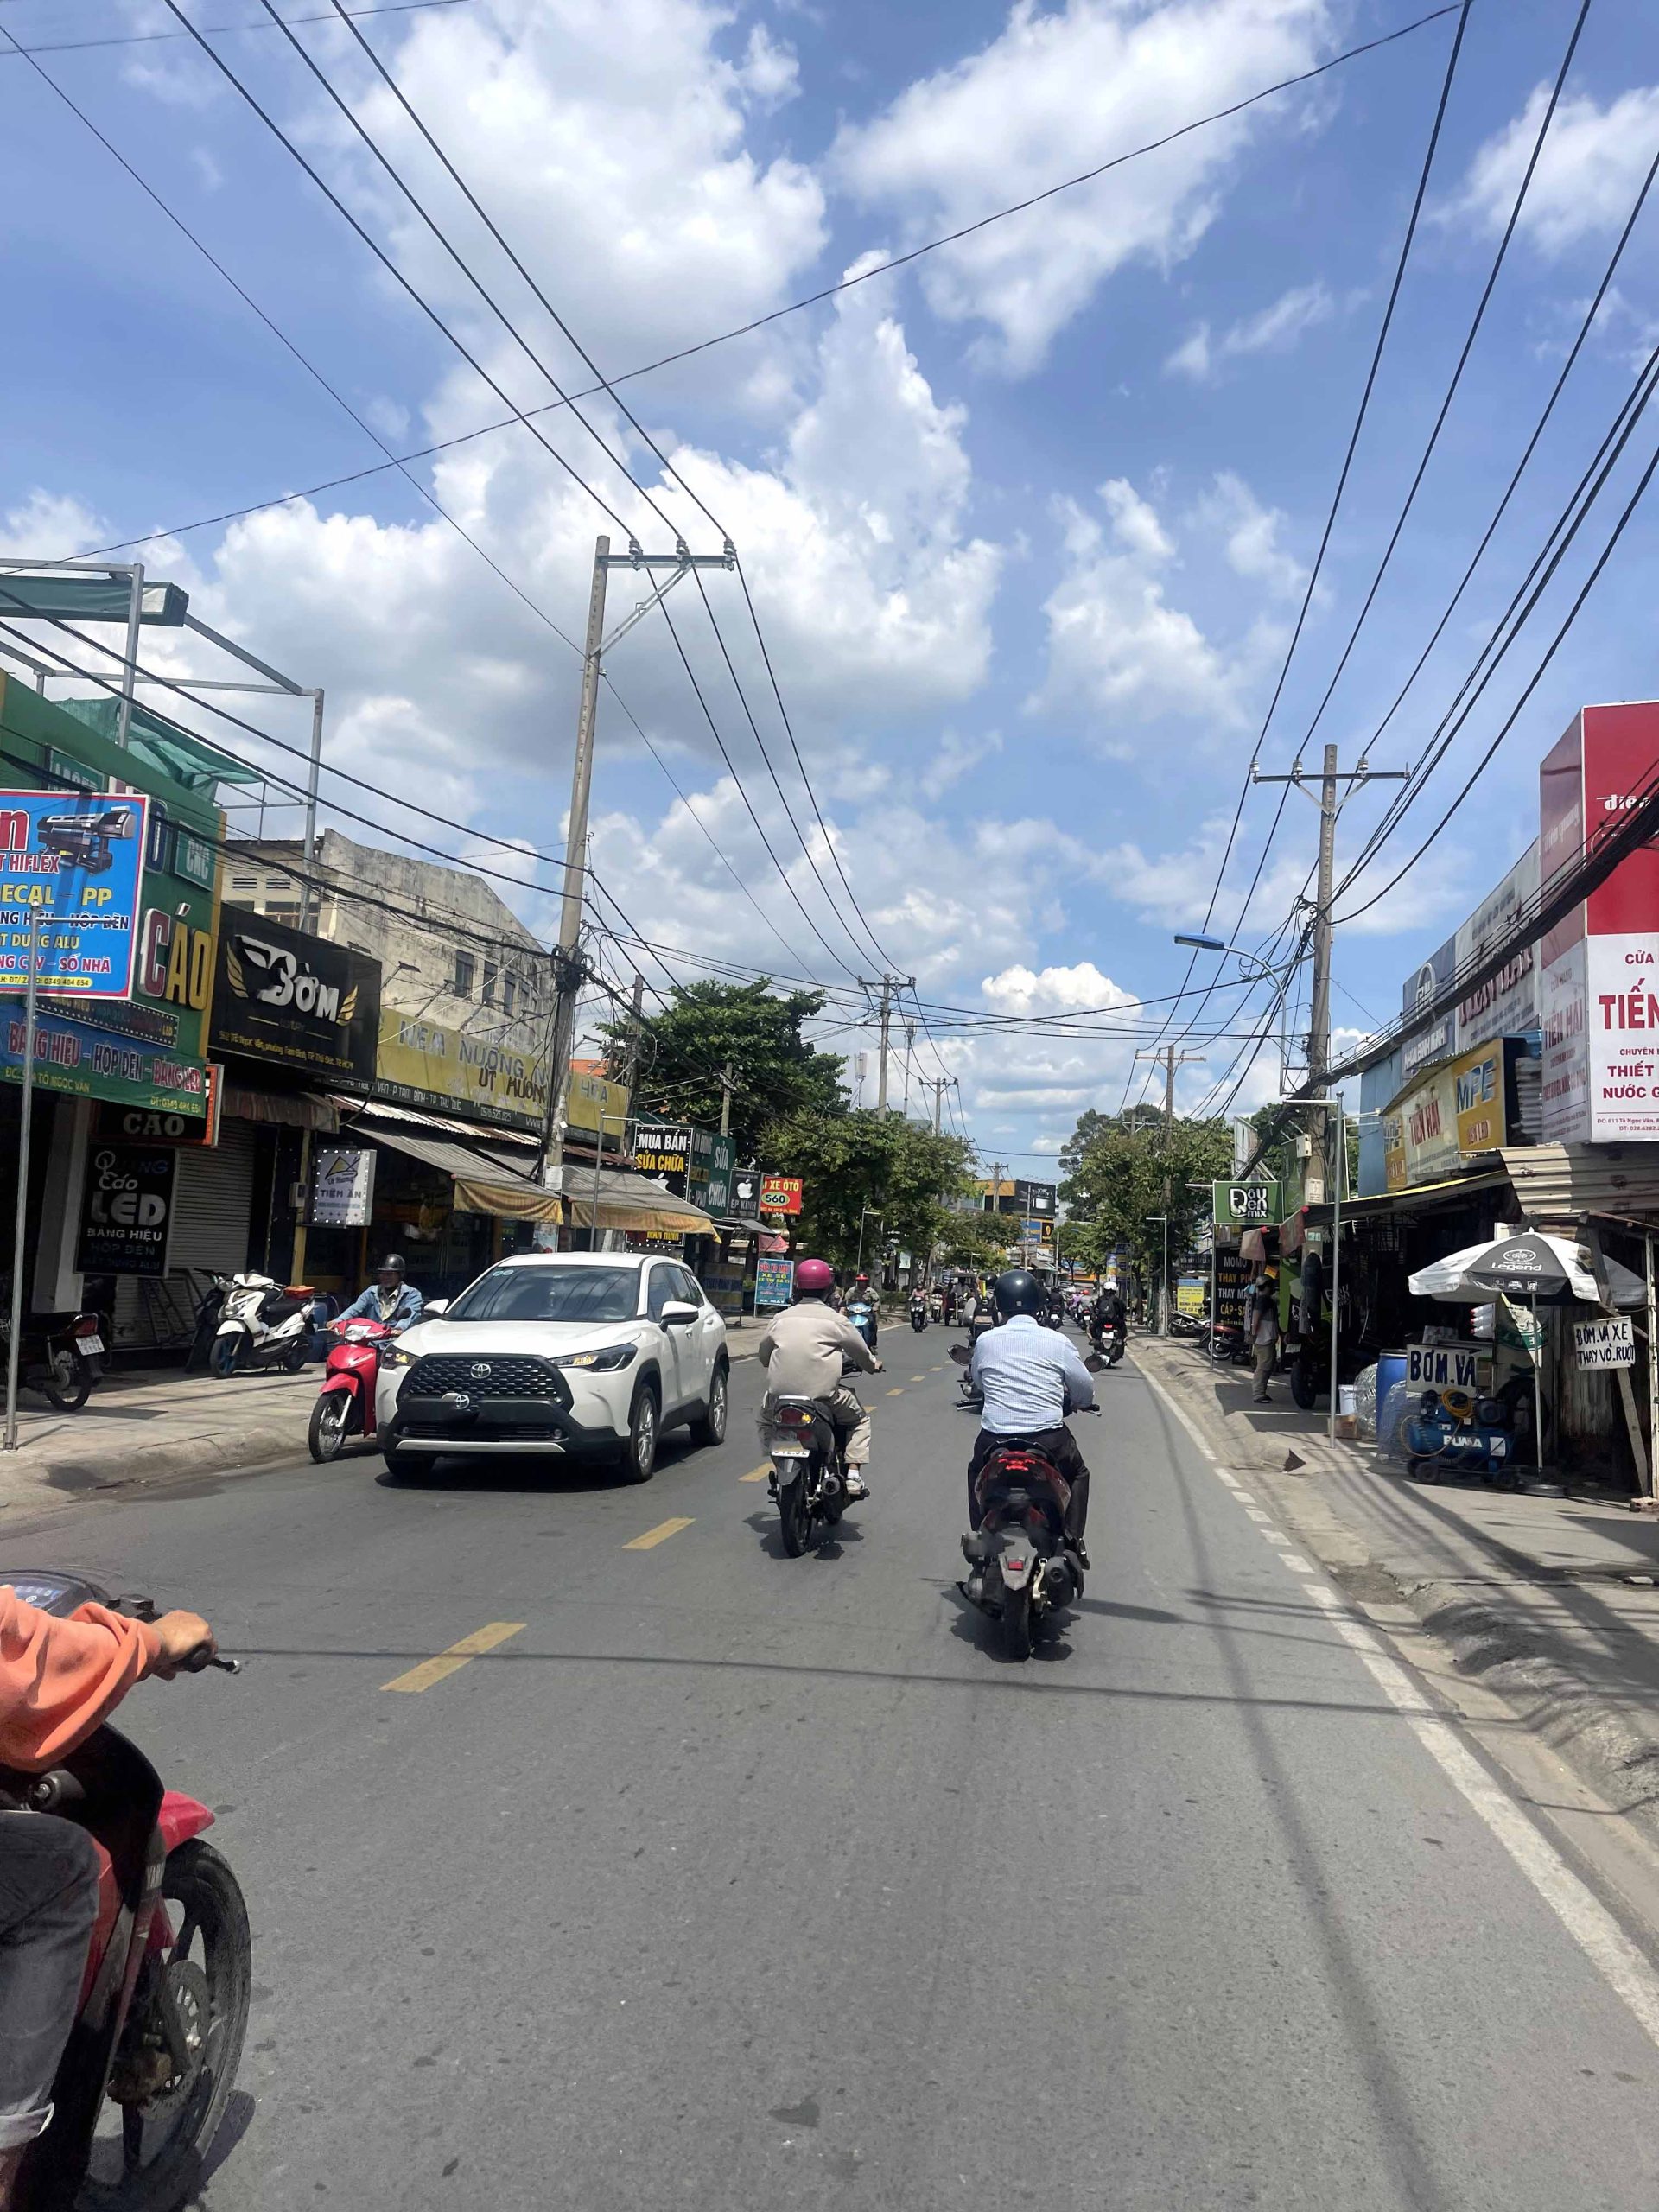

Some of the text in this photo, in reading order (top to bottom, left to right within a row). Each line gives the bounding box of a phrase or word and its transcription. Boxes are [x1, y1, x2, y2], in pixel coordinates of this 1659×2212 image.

[9, 854, 61, 874] HIFLEX
[0, 884, 112, 906] ECAL PP
[54, 936, 79, 949] ALU
[59, 952, 80, 971] SỐ
[81, 955, 111, 973] NHÀ
[140, 901, 213, 1010] CÁO
[1624, 949, 1654, 964] CỬA
[1607, 1060, 1654, 1077] THIẾT
[1456, 1058, 1496, 1115] MPE
[1603, 1084, 1646, 1098] NƯỚC
[123, 1109, 185, 1137] CÁO
[639, 1134, 661, 1150] MUA
[664, 1131, 687, 1151] BÁN
[637, 1149, 656, 1170] SỬA
[769, 1180, 780, 1191] XE
[766, 1194, 785, 1204] 560
[1218, 1272, 1237, 1284] THAY
[1218, 1287, 1235, 1299] THAY
[1612, 1322, 1628, 1340] XE
[1577, 1348, 1598, 1365] THAY
